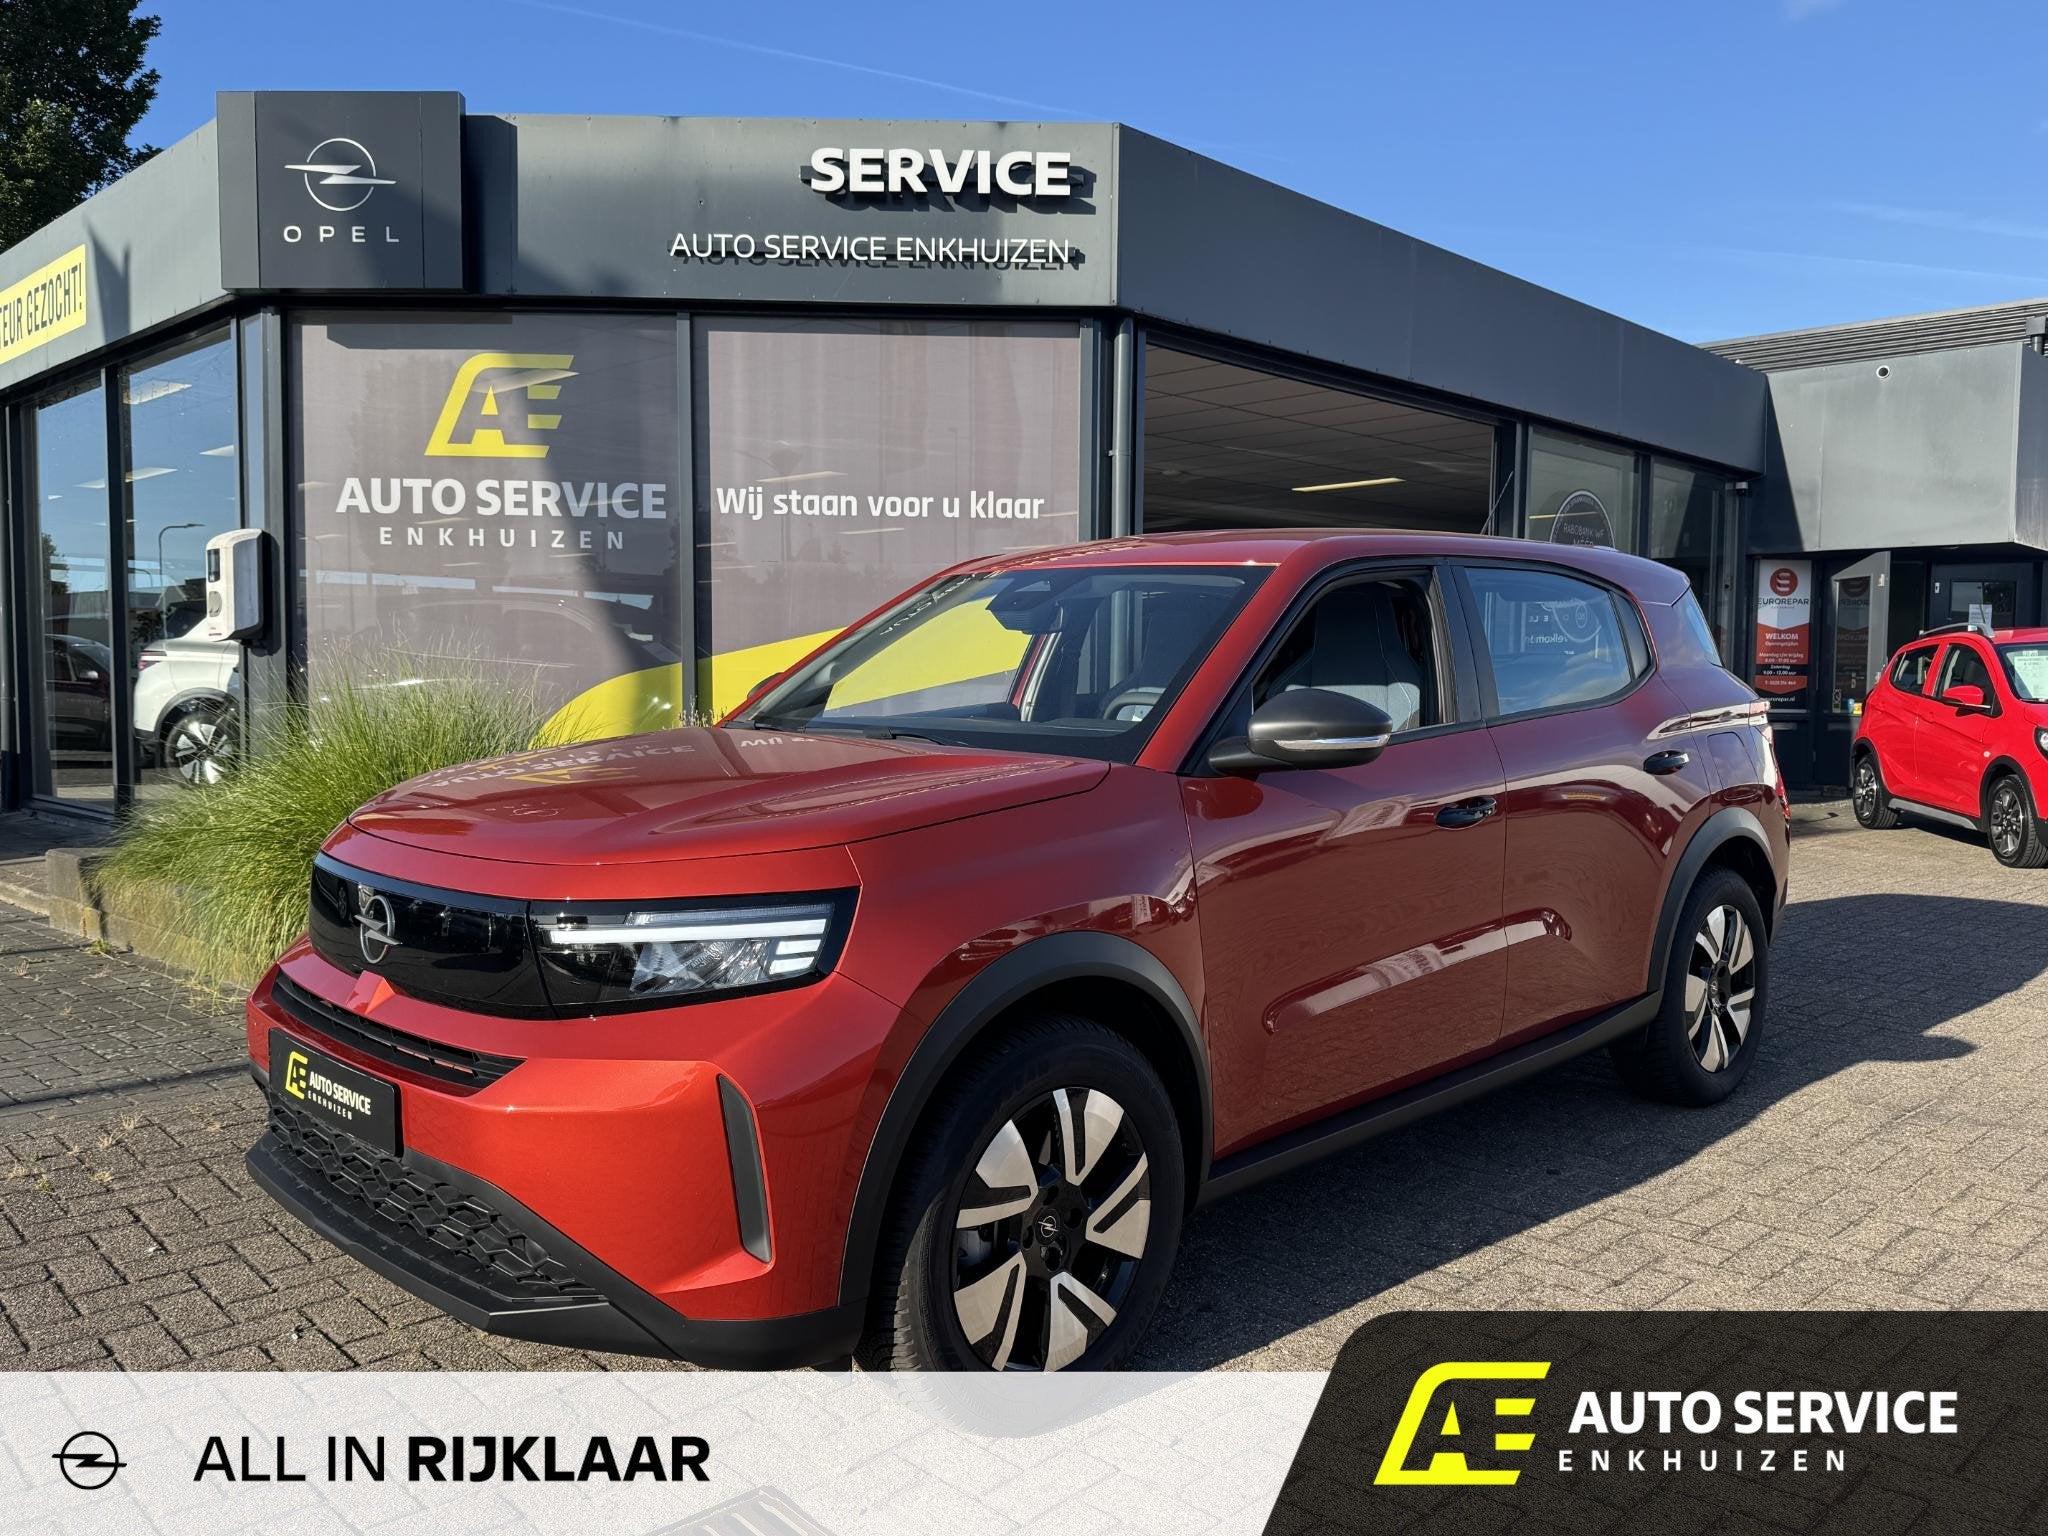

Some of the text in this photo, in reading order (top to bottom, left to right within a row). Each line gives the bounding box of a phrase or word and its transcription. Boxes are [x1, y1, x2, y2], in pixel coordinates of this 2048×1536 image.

[810, 147, 1071, 197] SERVICE
[283, 225, 400, 243] OPEL
[670, 233, 1070, 264] AUTO SERVICE ENKHUIZEN
[27, 262, 82, 336] GEZOCHT!
[336, 477, 667, 520] AUTO SERVICE
[716, 487, 1045, 521] Wij staan voor u klaar
[379, 527, 623, 550] ENKHUIZEN
[1765, 632, 1799, 640] WELKOM
[307, 1090, 353, 1120] ENKHUIZEN
[309, 1071, 372, 1115] AUTO SERVICE
